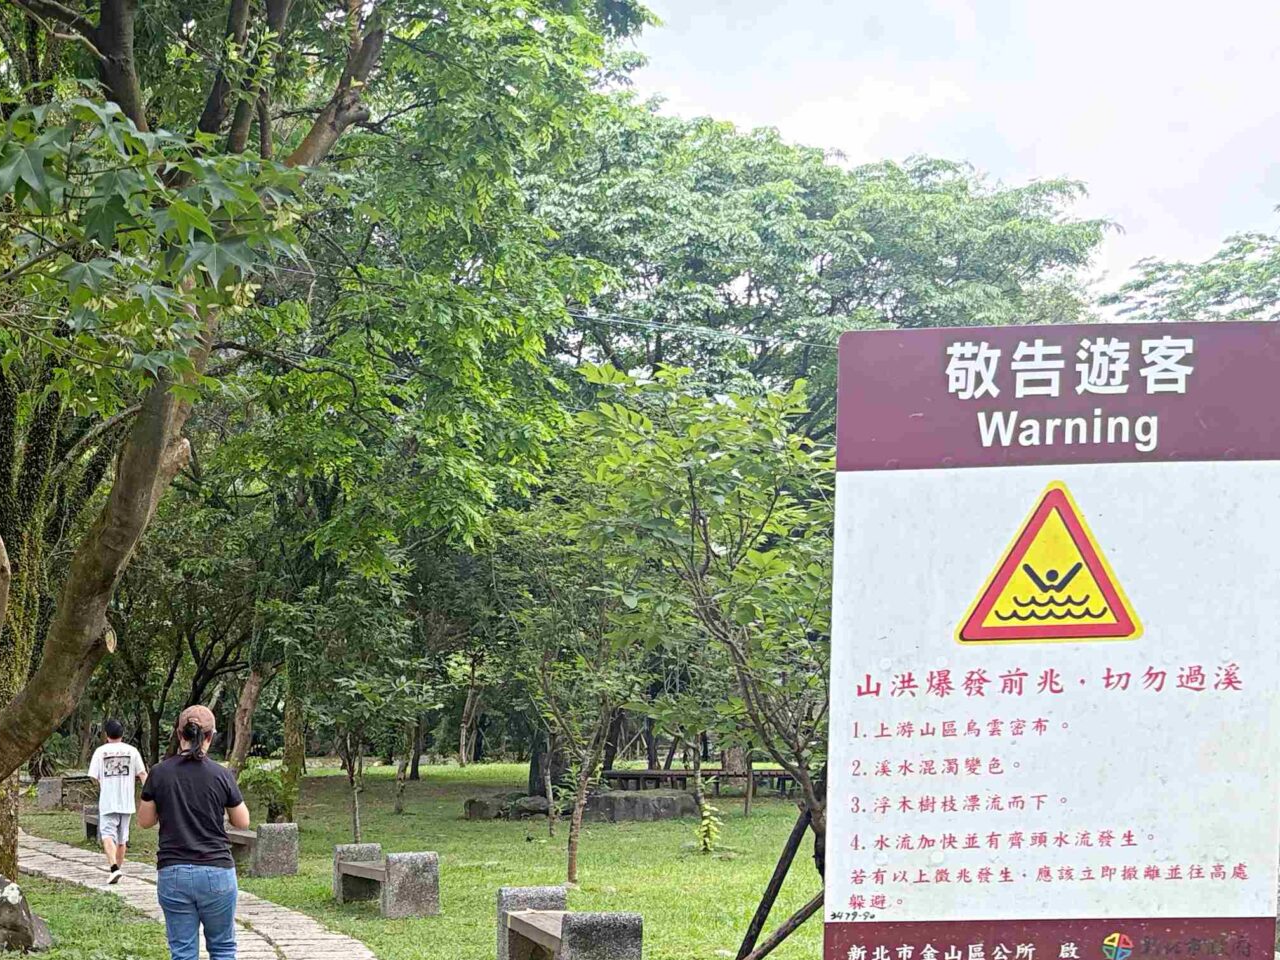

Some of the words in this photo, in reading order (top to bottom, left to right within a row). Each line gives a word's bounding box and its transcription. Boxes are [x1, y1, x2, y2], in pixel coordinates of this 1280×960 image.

[945, 335, 1195, 400] 敬告遊客
[976, 408, 1159, 452] Warning
[1058, 942, 1081, 960] 啟
